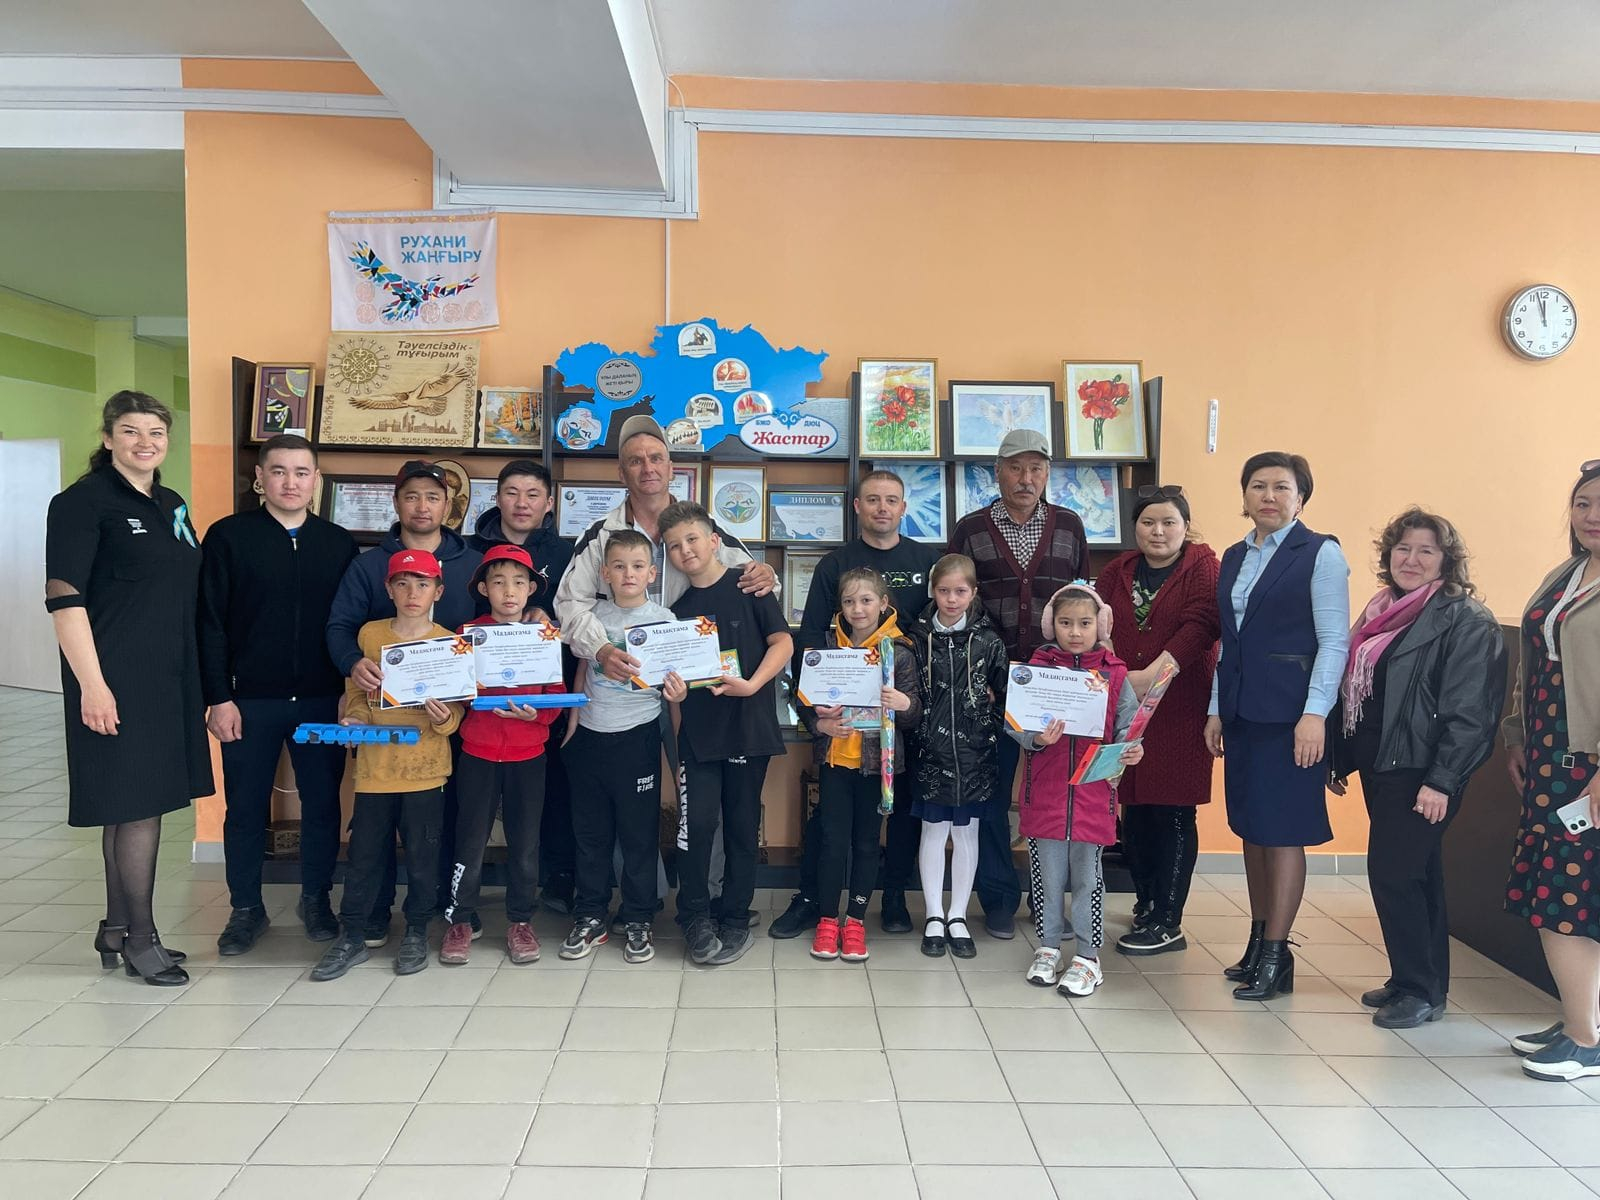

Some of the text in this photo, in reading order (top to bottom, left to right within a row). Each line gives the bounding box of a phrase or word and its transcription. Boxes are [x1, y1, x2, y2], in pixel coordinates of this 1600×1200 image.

[400, 235, 466, 248] РУХАНИ
[401, 250, 482, 265] ЖАҢҒЫРУ
[1529, 294, 1535, 302] 11
[1540, 291, 1549, 299] 12
[1514, 317, 1522, 325] 9
[396, 350, 460, 359] тұғырым
[751, 431, 830, 448] Жастар
[790, 496, 826, 504] ДИПЛОМ
[637, 774, 655, 785] FREE
[636, 781, 654, 793] FIRE
